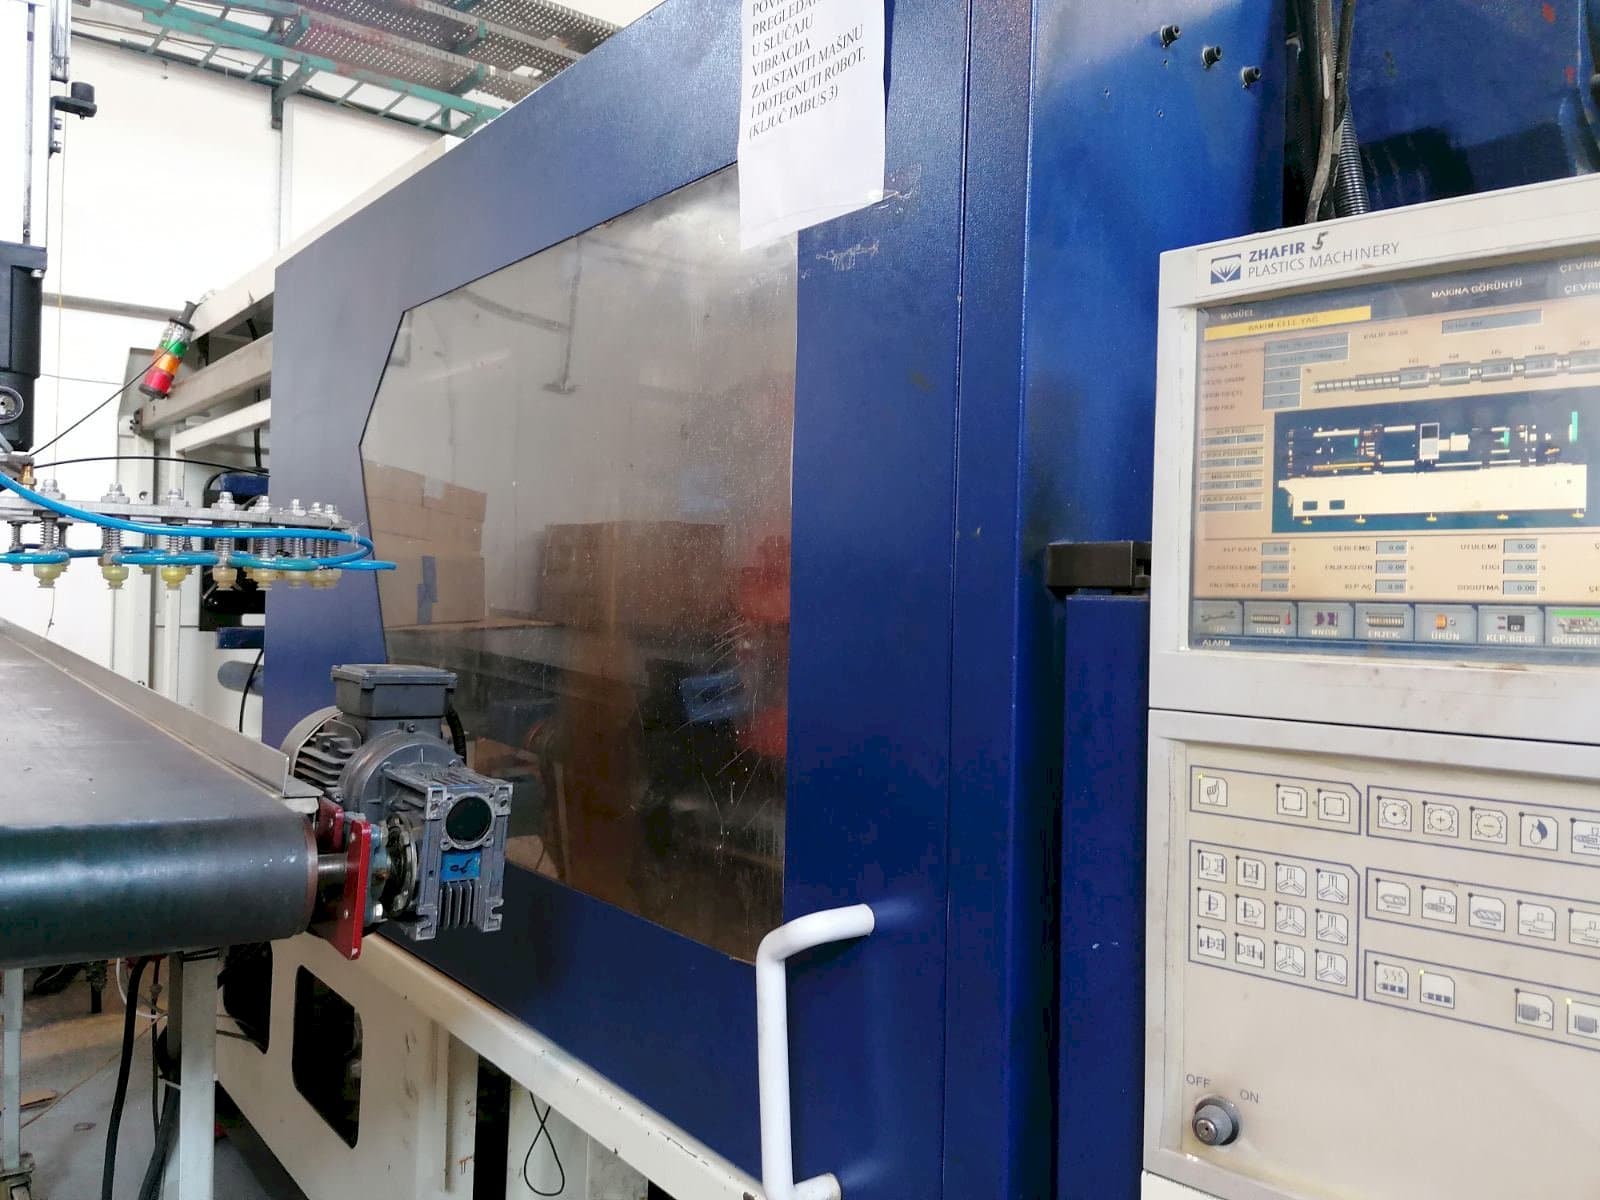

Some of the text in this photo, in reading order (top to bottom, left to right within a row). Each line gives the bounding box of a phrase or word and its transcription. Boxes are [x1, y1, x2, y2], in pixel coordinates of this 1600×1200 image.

[752, 14, 813, 57] U SLUČAJU
[751, 23, 863, 99] ZAUSTAVITI MAŠINU
[757, 72, 822, 116] DOTEGNUTI
[824, 46, 866, 82] ROBOT.
[749, 84, 839, 142] (KLJUČ IMBUS 3)
[1249, 242, 1306, 263] ZHAFIR
[1311, 231, 1329, 251] 5
[1248, 242, 1400, 279] PLASTICS MACHINERY
[1202, 638, 1231, 648] ALARM
[1186, 1073, 1211, 1088] OFF
[1239, 1088, 1259, 1104] ON
